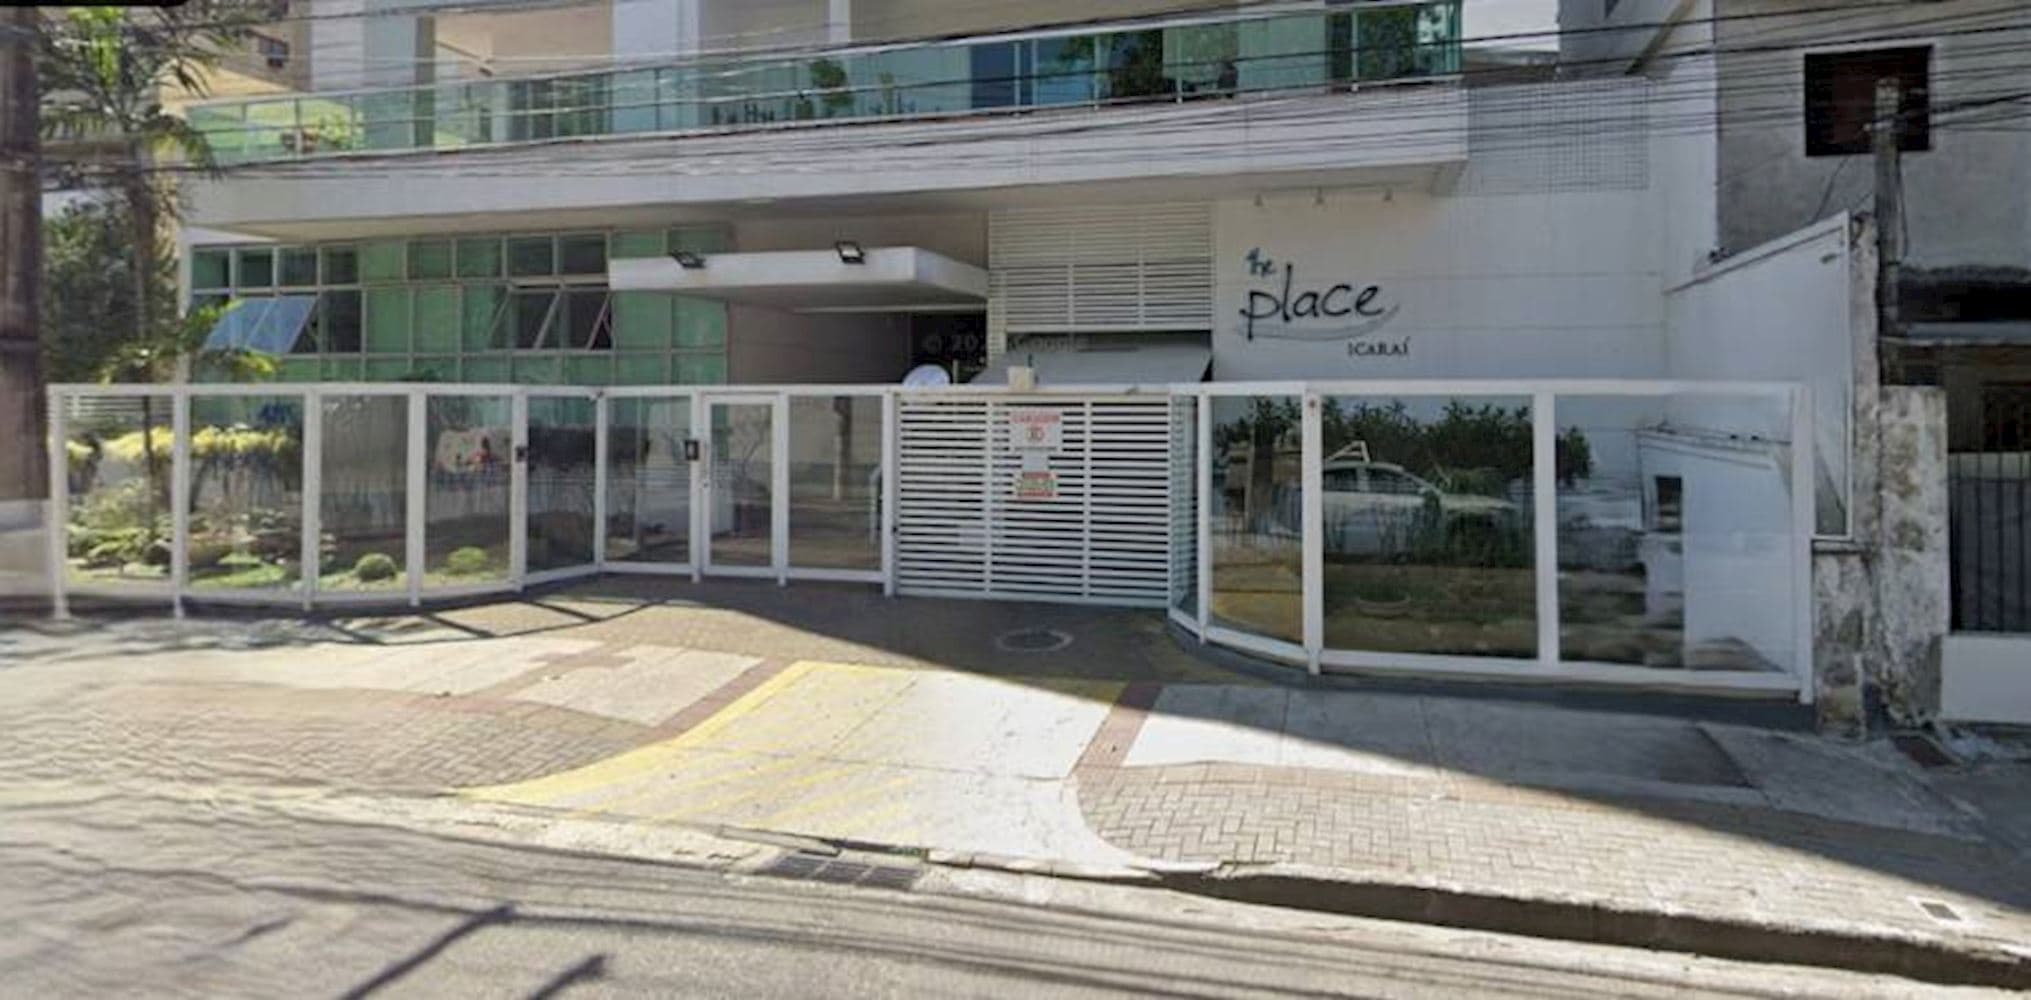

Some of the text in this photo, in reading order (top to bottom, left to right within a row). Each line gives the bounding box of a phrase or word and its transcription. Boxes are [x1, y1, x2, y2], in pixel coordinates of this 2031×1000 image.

[1246, 247, 1275, 276] the
[1239, 263, 1385, 341] place
[1348, 336, 1410, 356] ICARAÍ
